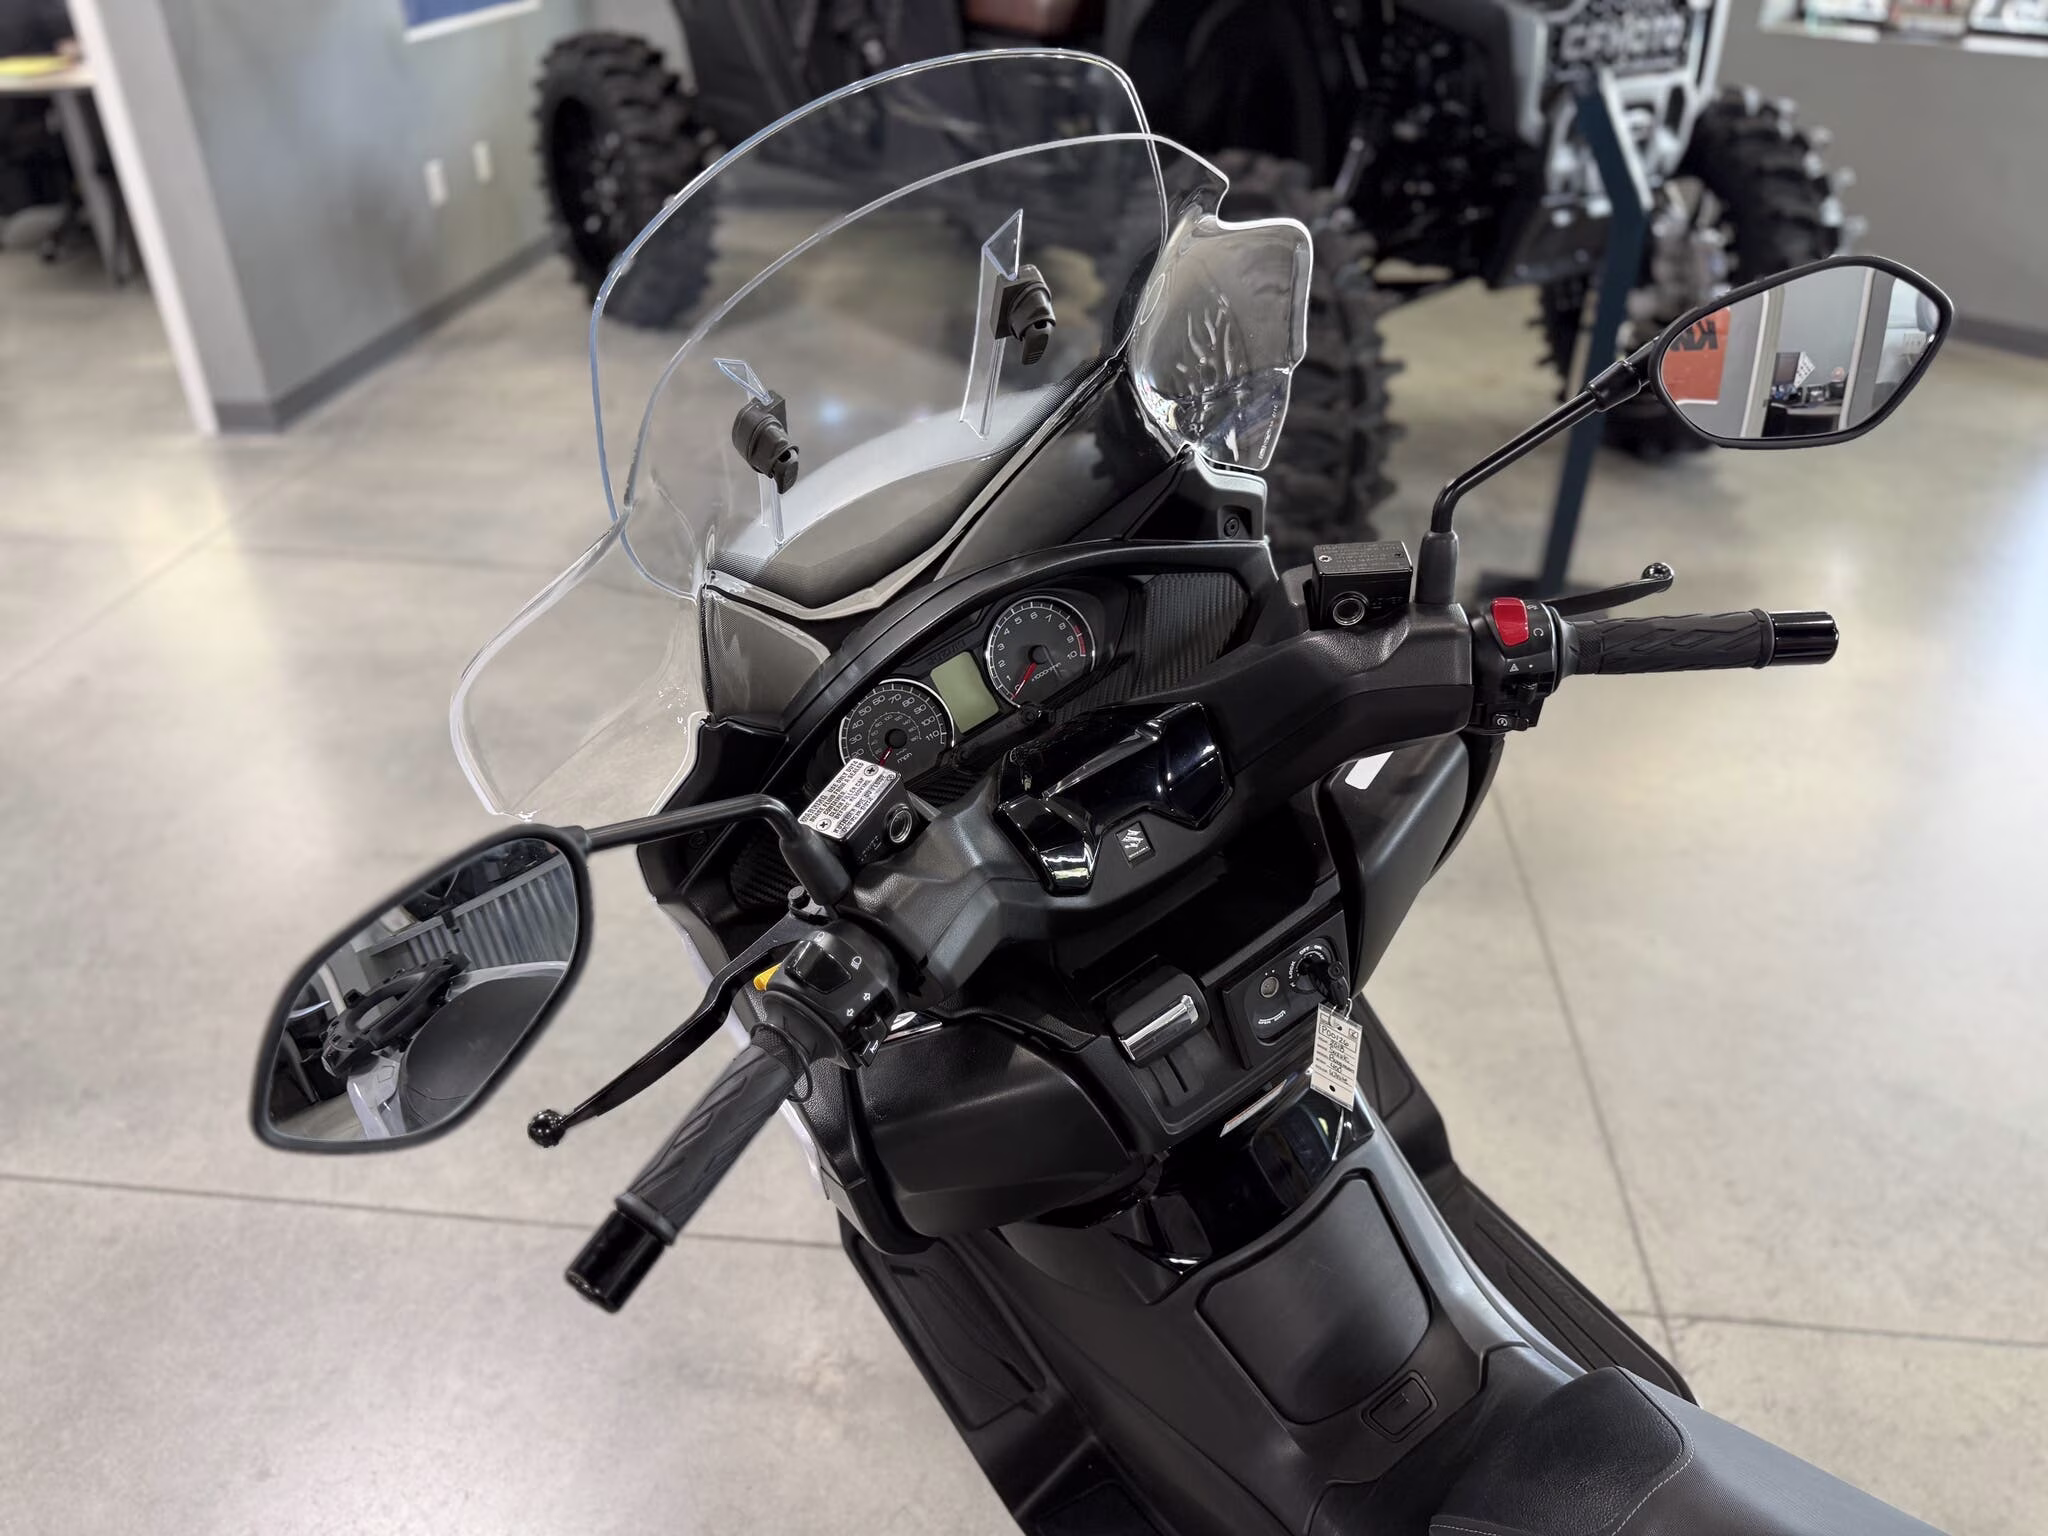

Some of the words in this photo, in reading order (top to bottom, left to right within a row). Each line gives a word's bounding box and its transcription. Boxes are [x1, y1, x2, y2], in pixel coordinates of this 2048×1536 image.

[1014, 616, 1022, 624] 5
[1045, 614, 1052, 622] 7
[1004, 628, 1010, 636] 4
[998, 643, 1005, 651] 3
[1067, 650, 1078, 660] 10
[998, 660, 1006, 668] 2
[888, 694, 902, 704] 70
[902, 696, 916, 708] 80
[858, 706, 872, 716] 50
[852, 719, 864, 730] 40
[921, 715, 936, 726] 100
[849, 734, 862, 744] 30
[926, 730, 940, 741] 110
